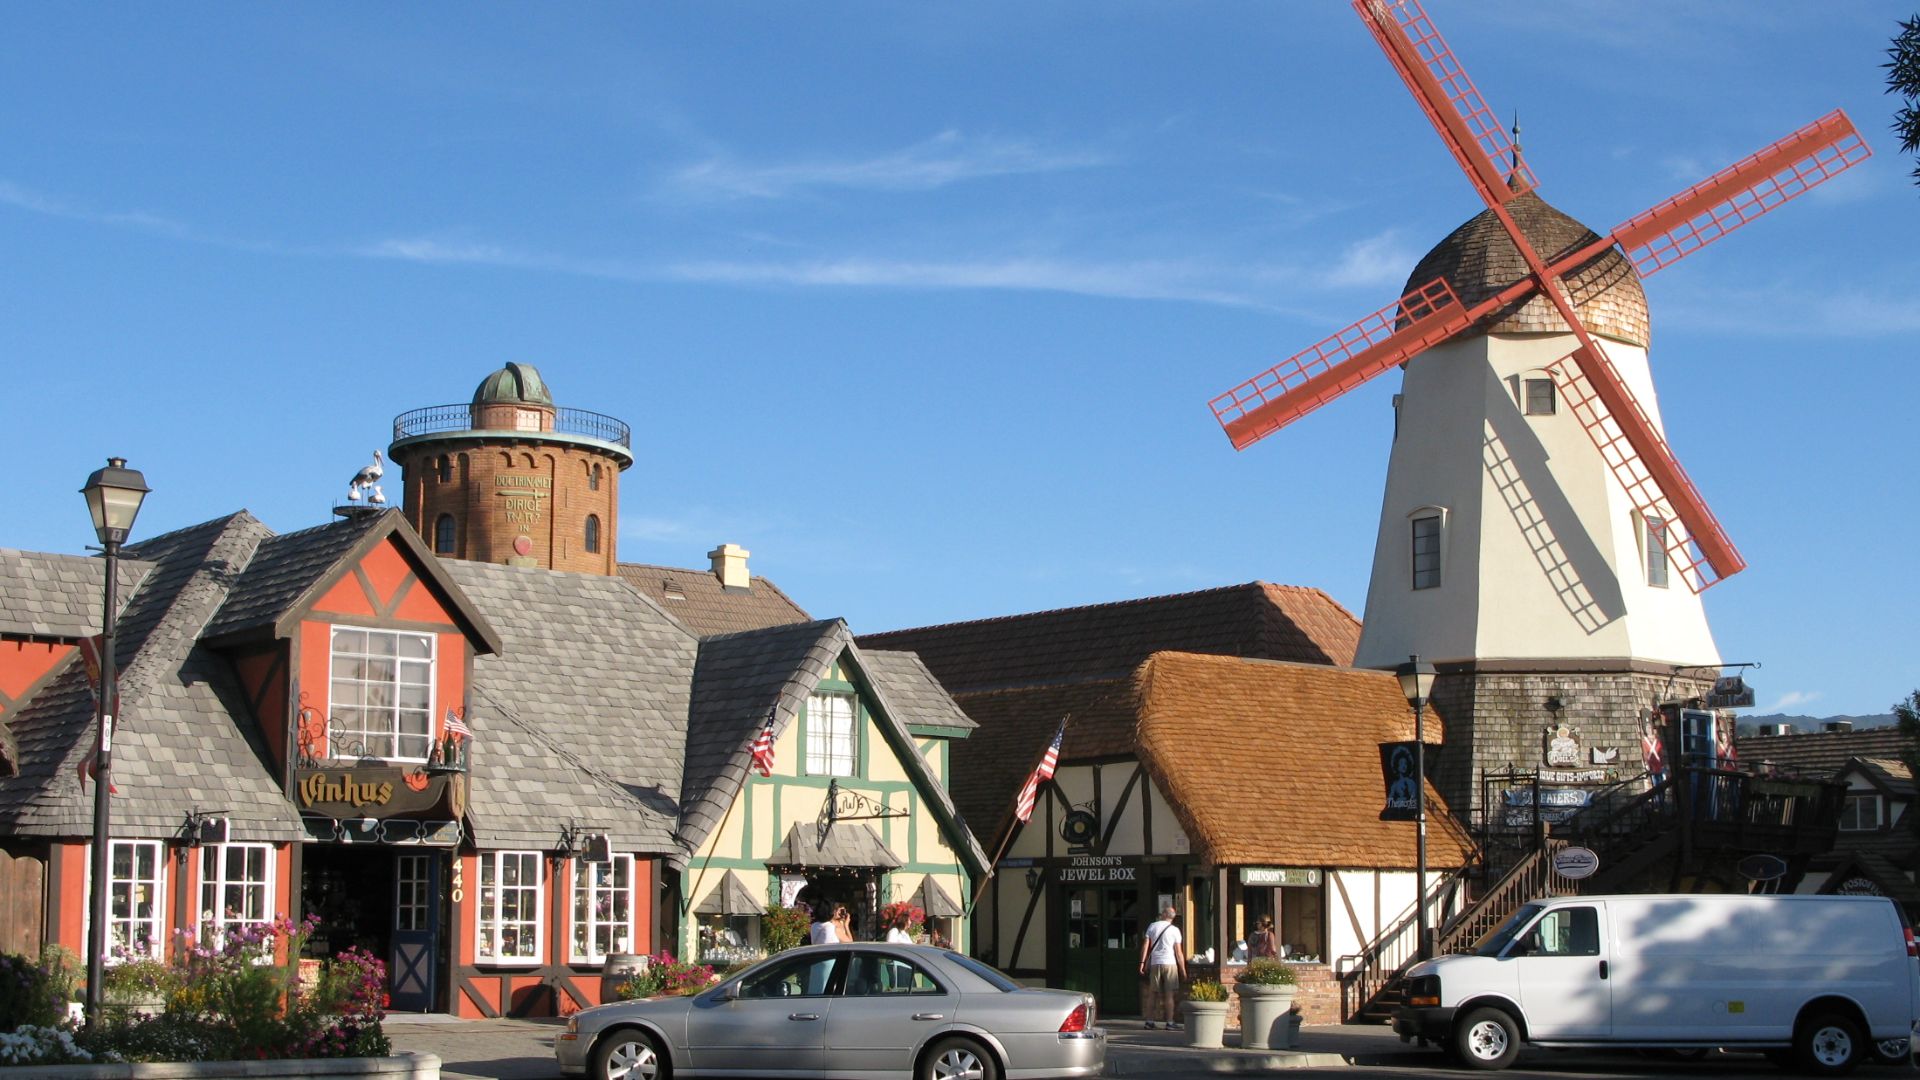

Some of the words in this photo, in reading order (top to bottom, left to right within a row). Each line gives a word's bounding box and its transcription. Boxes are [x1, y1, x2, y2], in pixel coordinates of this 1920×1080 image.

[505, 498, 541, 511] DIRIGE
[300, 772, 393, 808] Vinhus
[1071, 856, 1122, 866] JOHNSON'S
[1060, 868, 1105, 880] JEWEL
[1109, 867, 1136, 880] BOX
[1246, 869, 1286, 883] JOHNSON'S
[452, 858, 464, 903] 440
